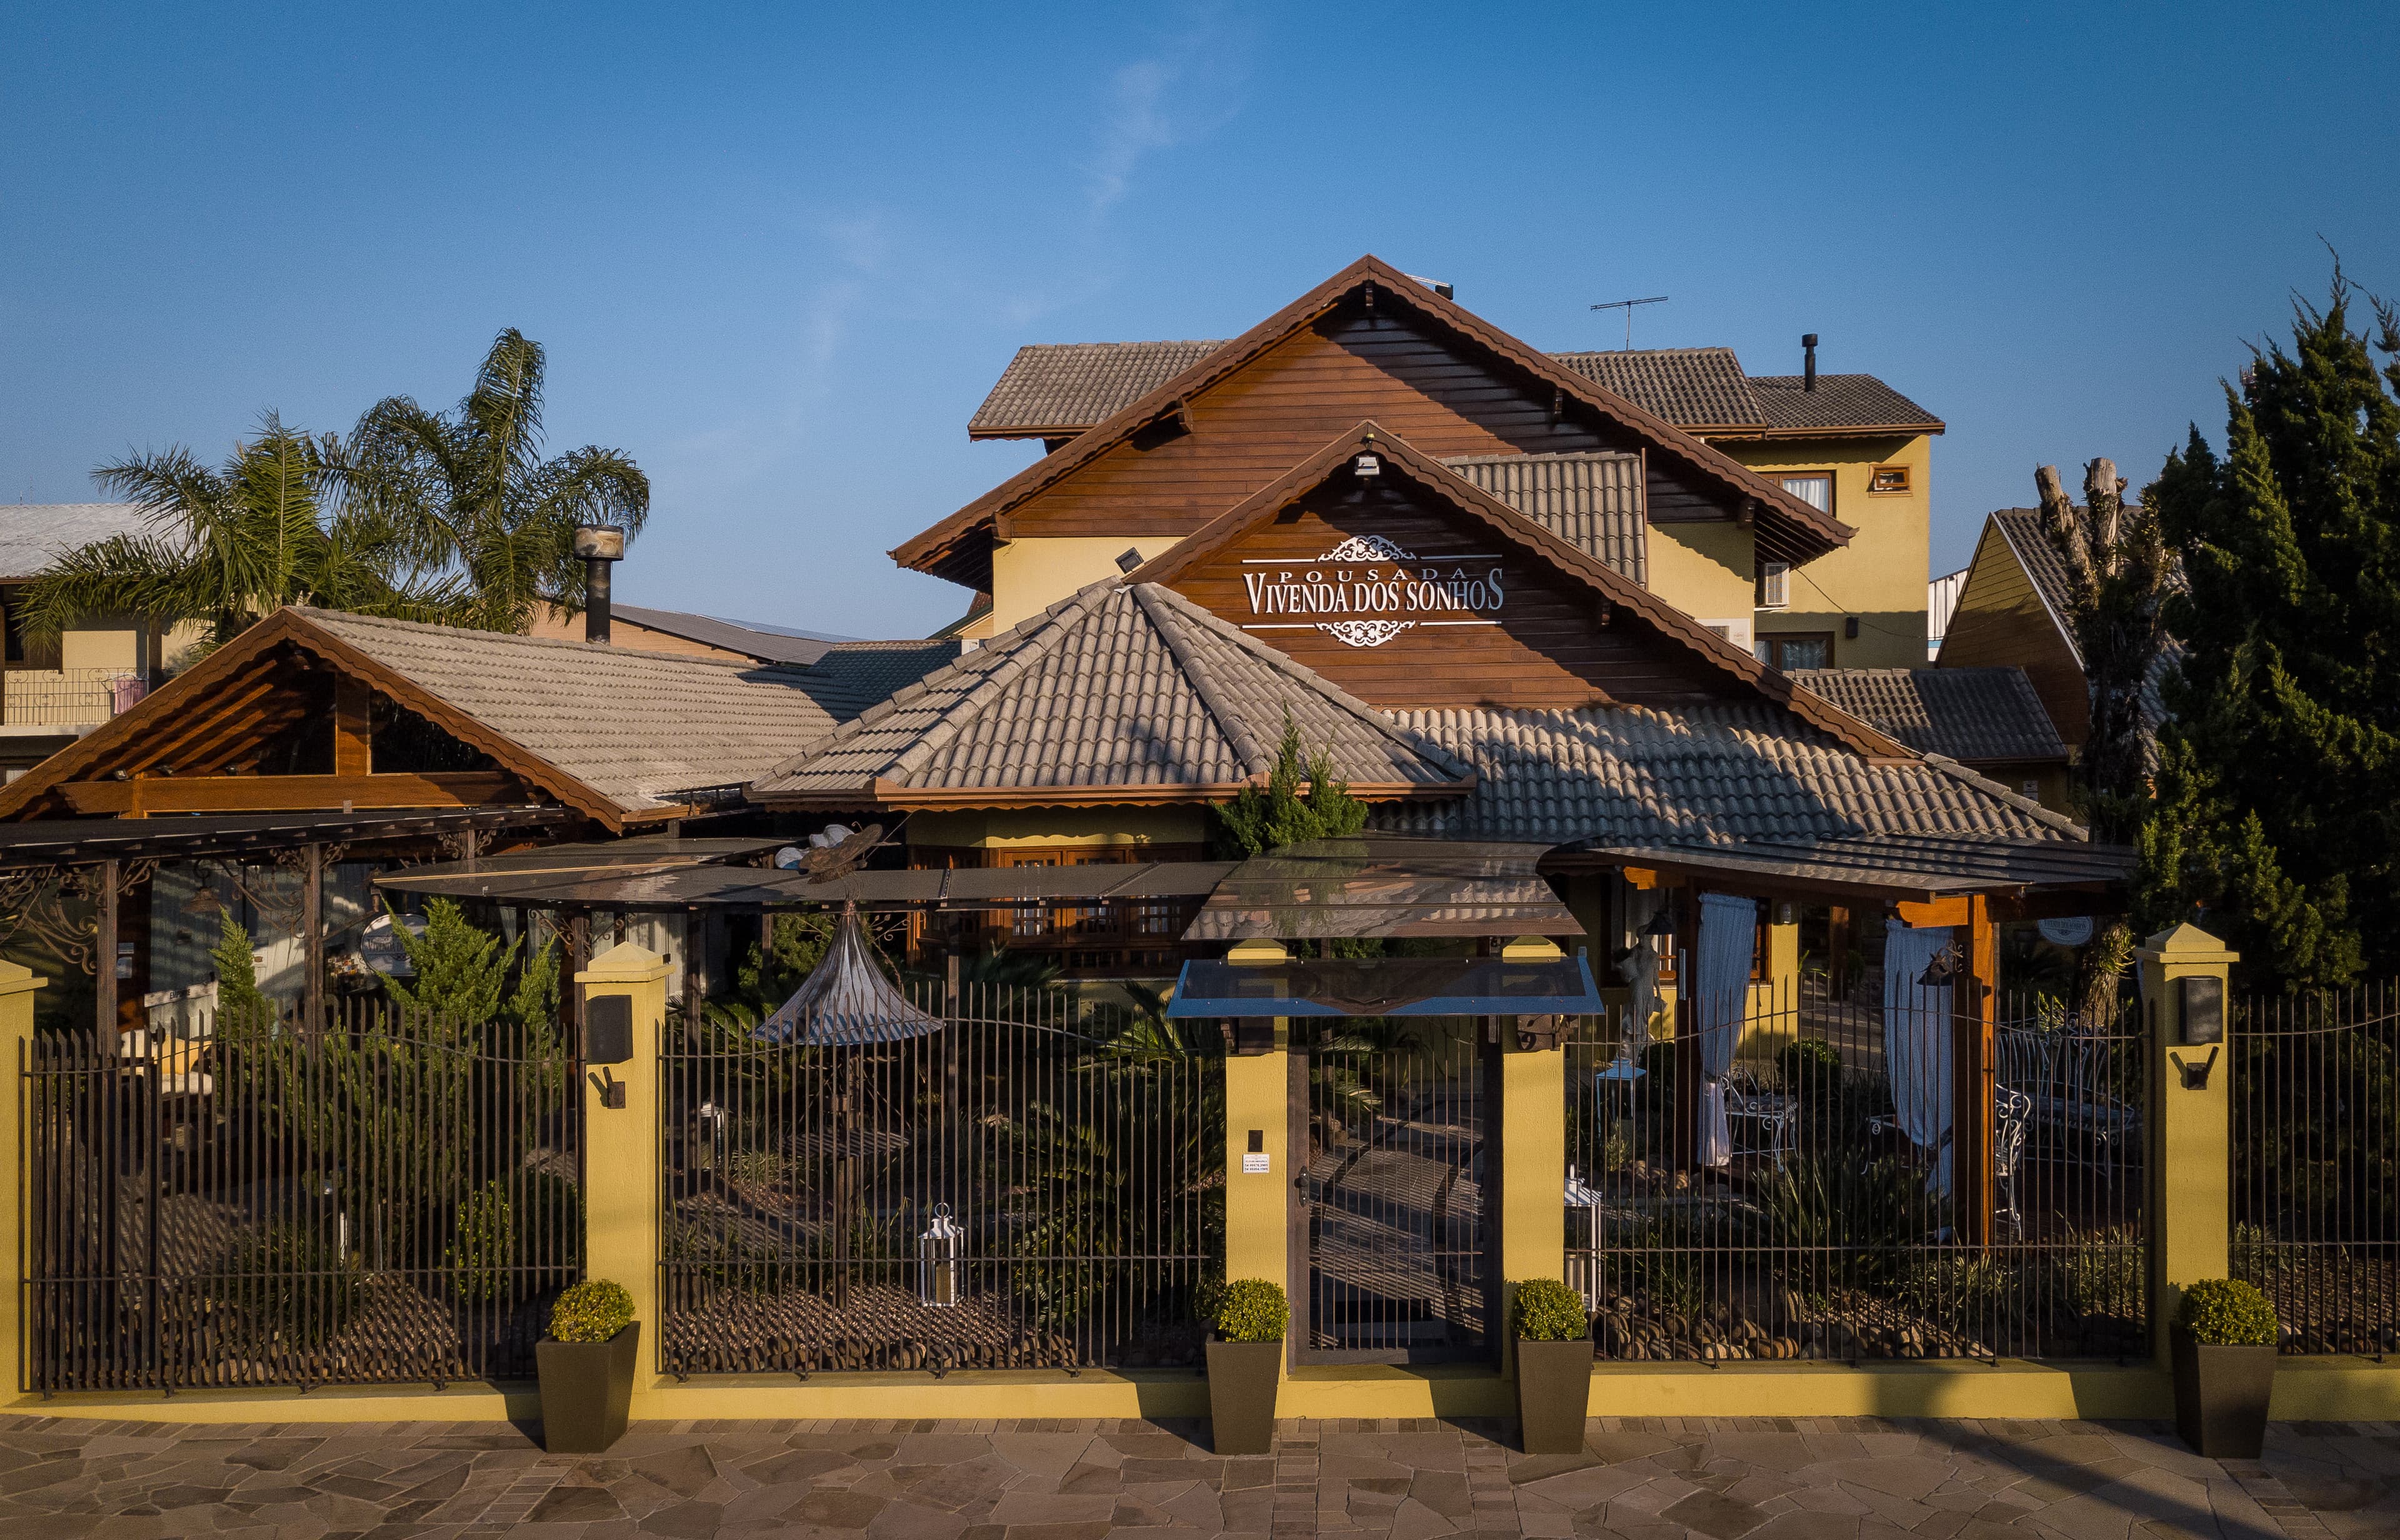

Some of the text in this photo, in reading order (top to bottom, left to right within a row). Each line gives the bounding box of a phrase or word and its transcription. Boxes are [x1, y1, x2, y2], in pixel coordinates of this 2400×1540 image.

[1279, 568, 1468, 583] POUSADA
[1243, 568, 1503, 614] VIVENDA DOS SONHOS
